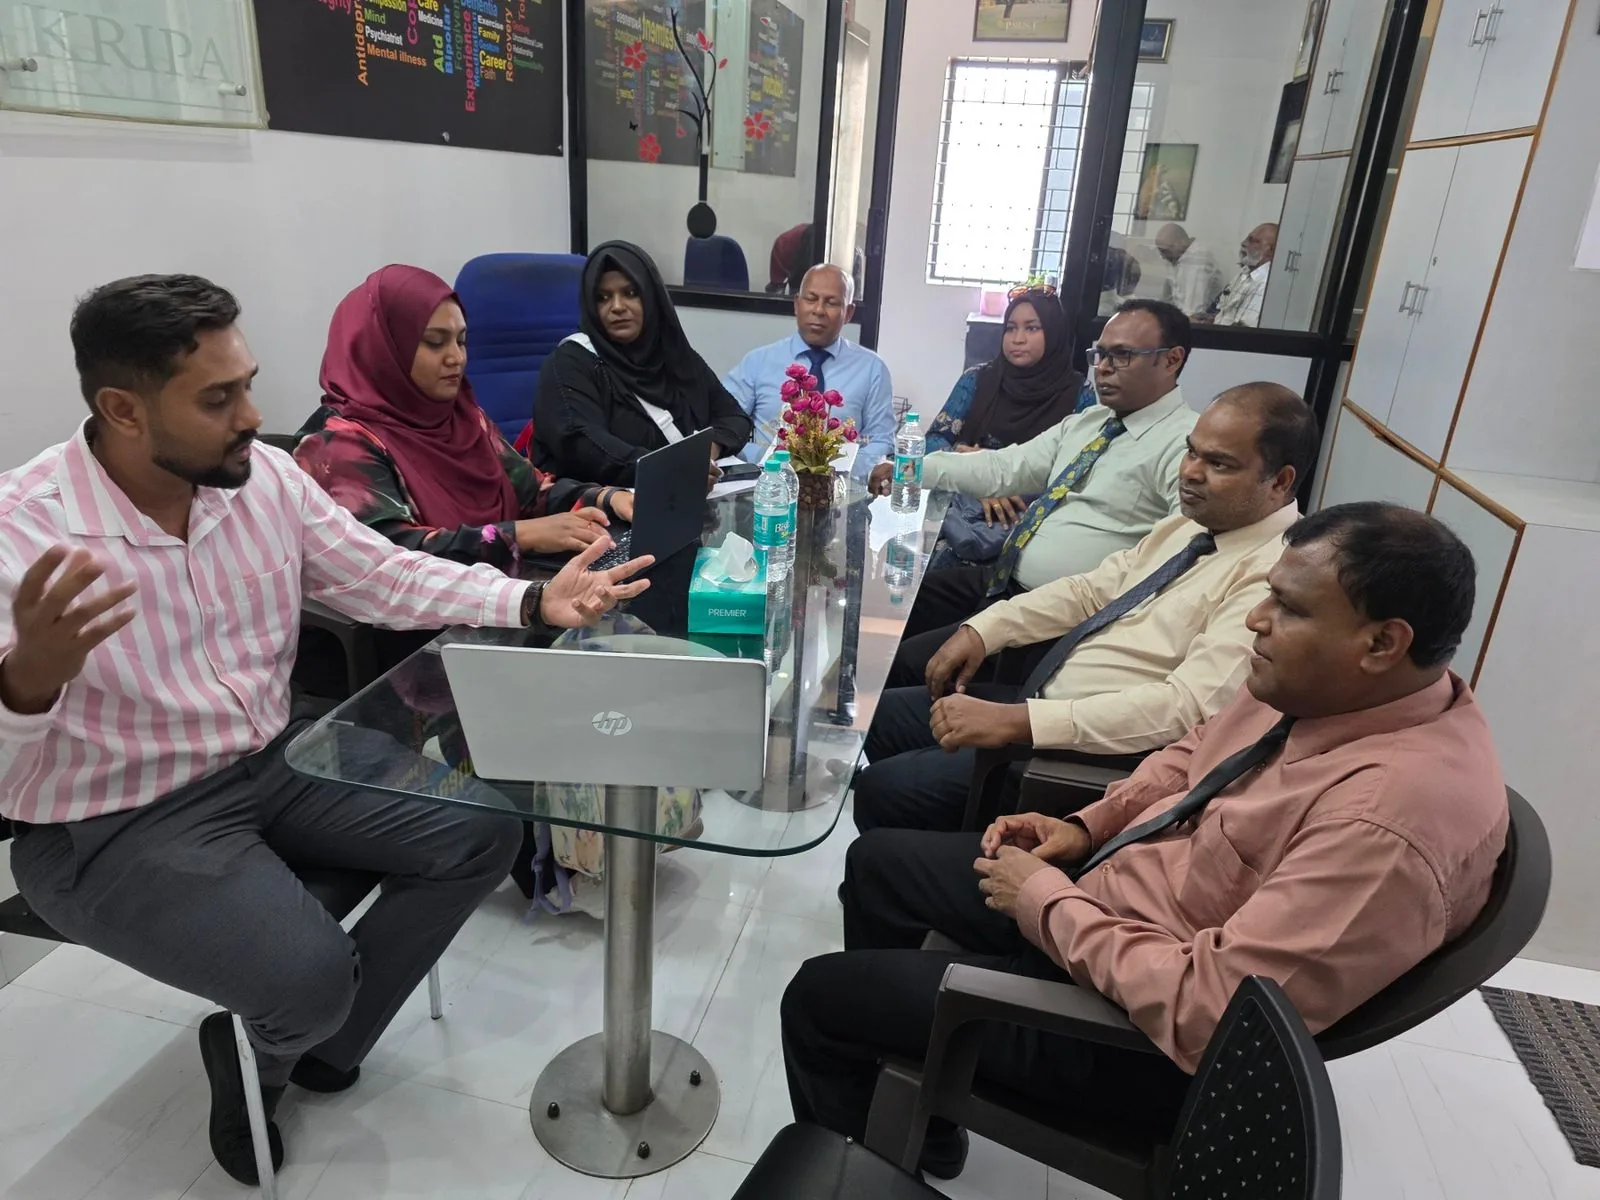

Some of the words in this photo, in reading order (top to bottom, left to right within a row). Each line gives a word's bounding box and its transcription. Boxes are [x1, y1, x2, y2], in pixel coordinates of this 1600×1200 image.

[364, 8, 386, 25] Mind
[417, 10, 444, 28] Medicine
[477, 14, 504, 31] Exercise
[22, 2, 234, 84] KRIPA
[354, 0, 369, 86] Antidepr
[365, 25, 403, 46] Psychiatrist
[444, 4, 453, 74] Bipolar
[477, 26, 500, 43] Family
[505, 7, 514, 82] Recovery
[366, 43, 398, 60] Mental
[399, 50, 428, 67] illness
[433, 34, 445, 73] Aid
[463, 9, 476, 112] Experience
[479, 50, 507, 70] Career
[707, 608, 748, 617] PREMIER
[591, 710, 632, 736] hp
